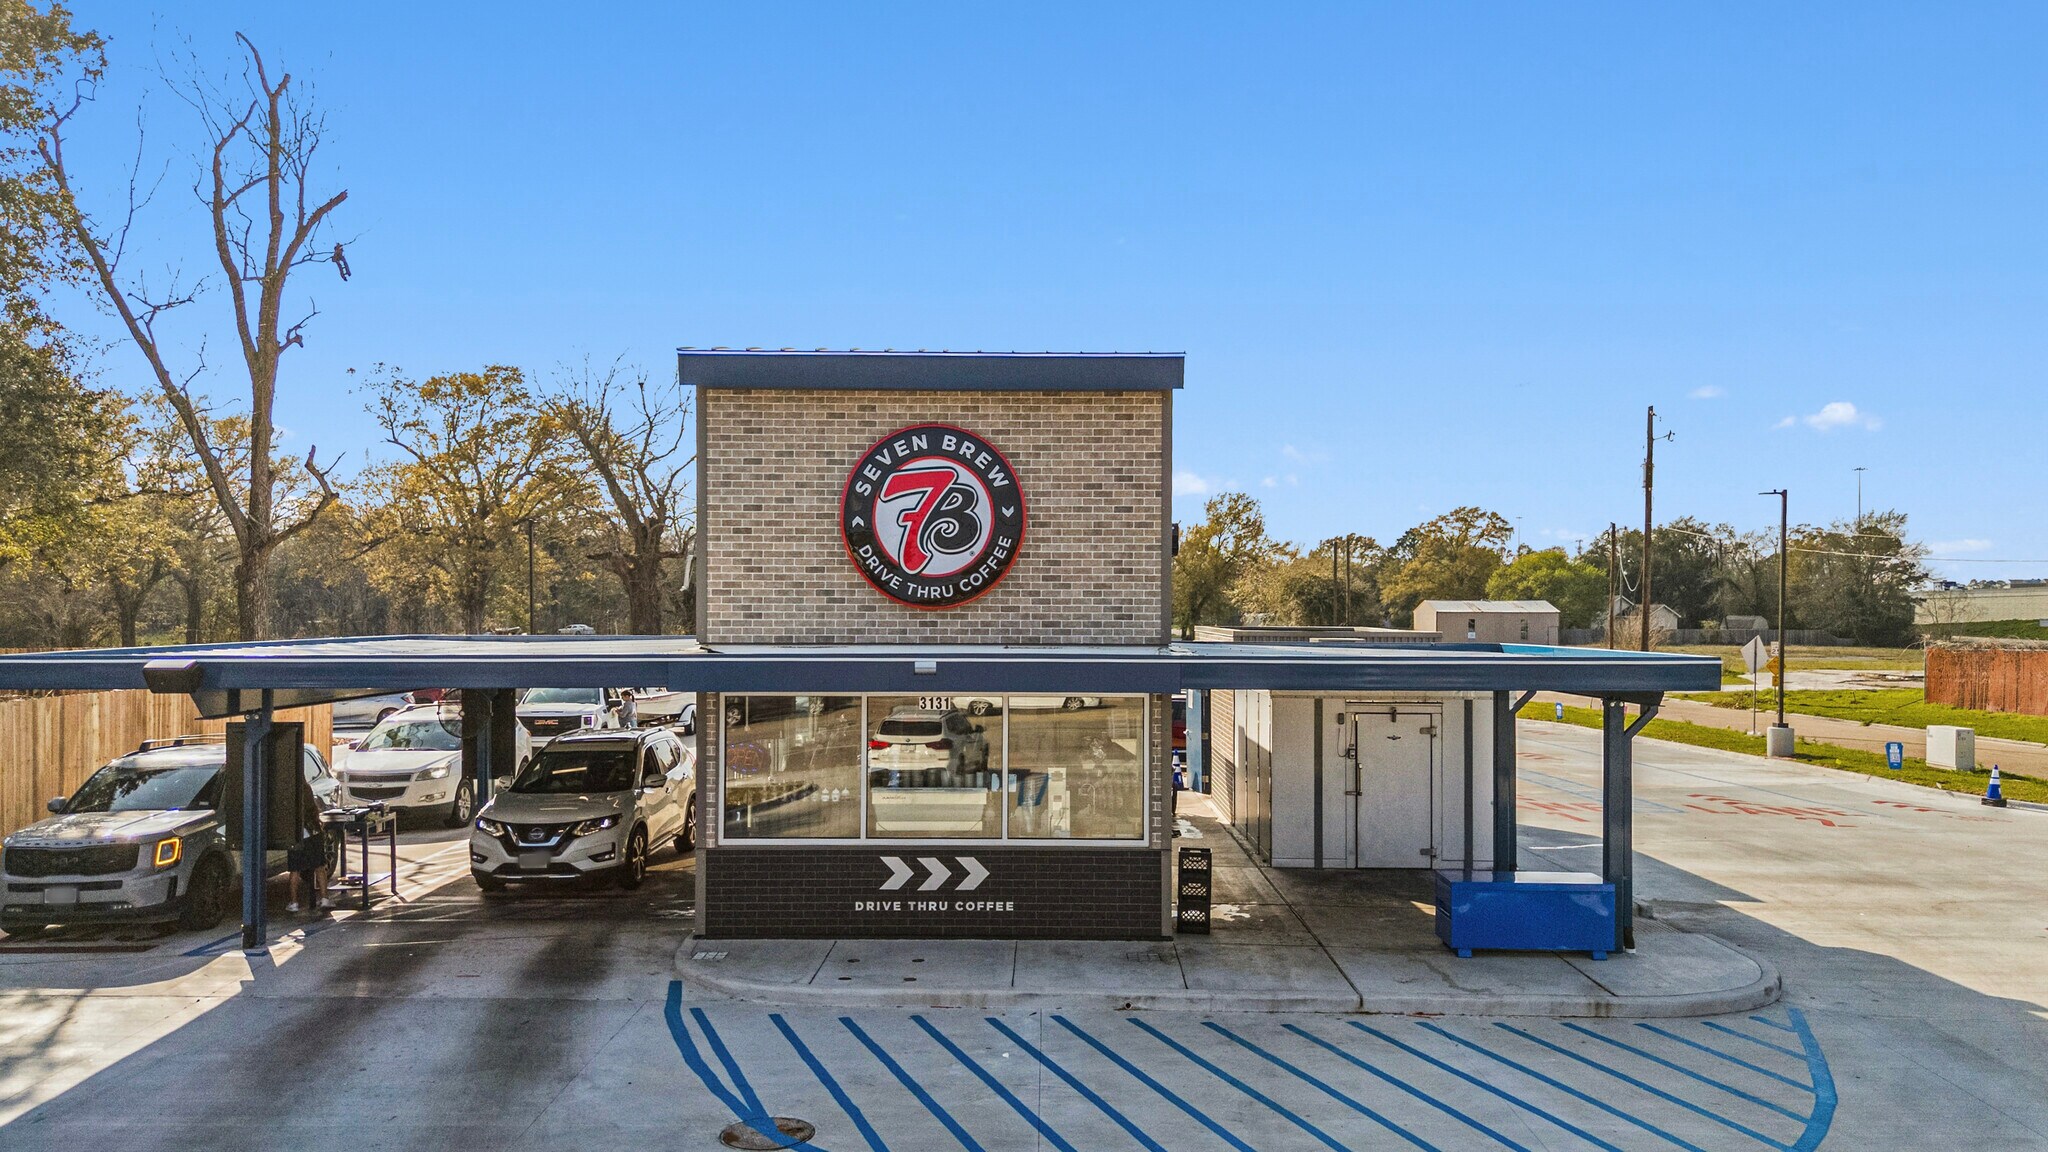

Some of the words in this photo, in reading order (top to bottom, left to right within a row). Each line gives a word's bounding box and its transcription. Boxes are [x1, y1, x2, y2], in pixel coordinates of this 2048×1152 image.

[855, 434, 928, 497] SEVEN
[941, 434, 1010, 488] BREW
[858, 544, 903, 590] DRIVE
[907, 582, 954, 599] THRU
[959, 535, 1012, 592] COFFEE
[920, 697, 949, 709] 3131
[855, 901, 901, 911] DRIVE
[908, 901, 948, 911] THRU
[955, 901, 1014, 911] COFFEE
